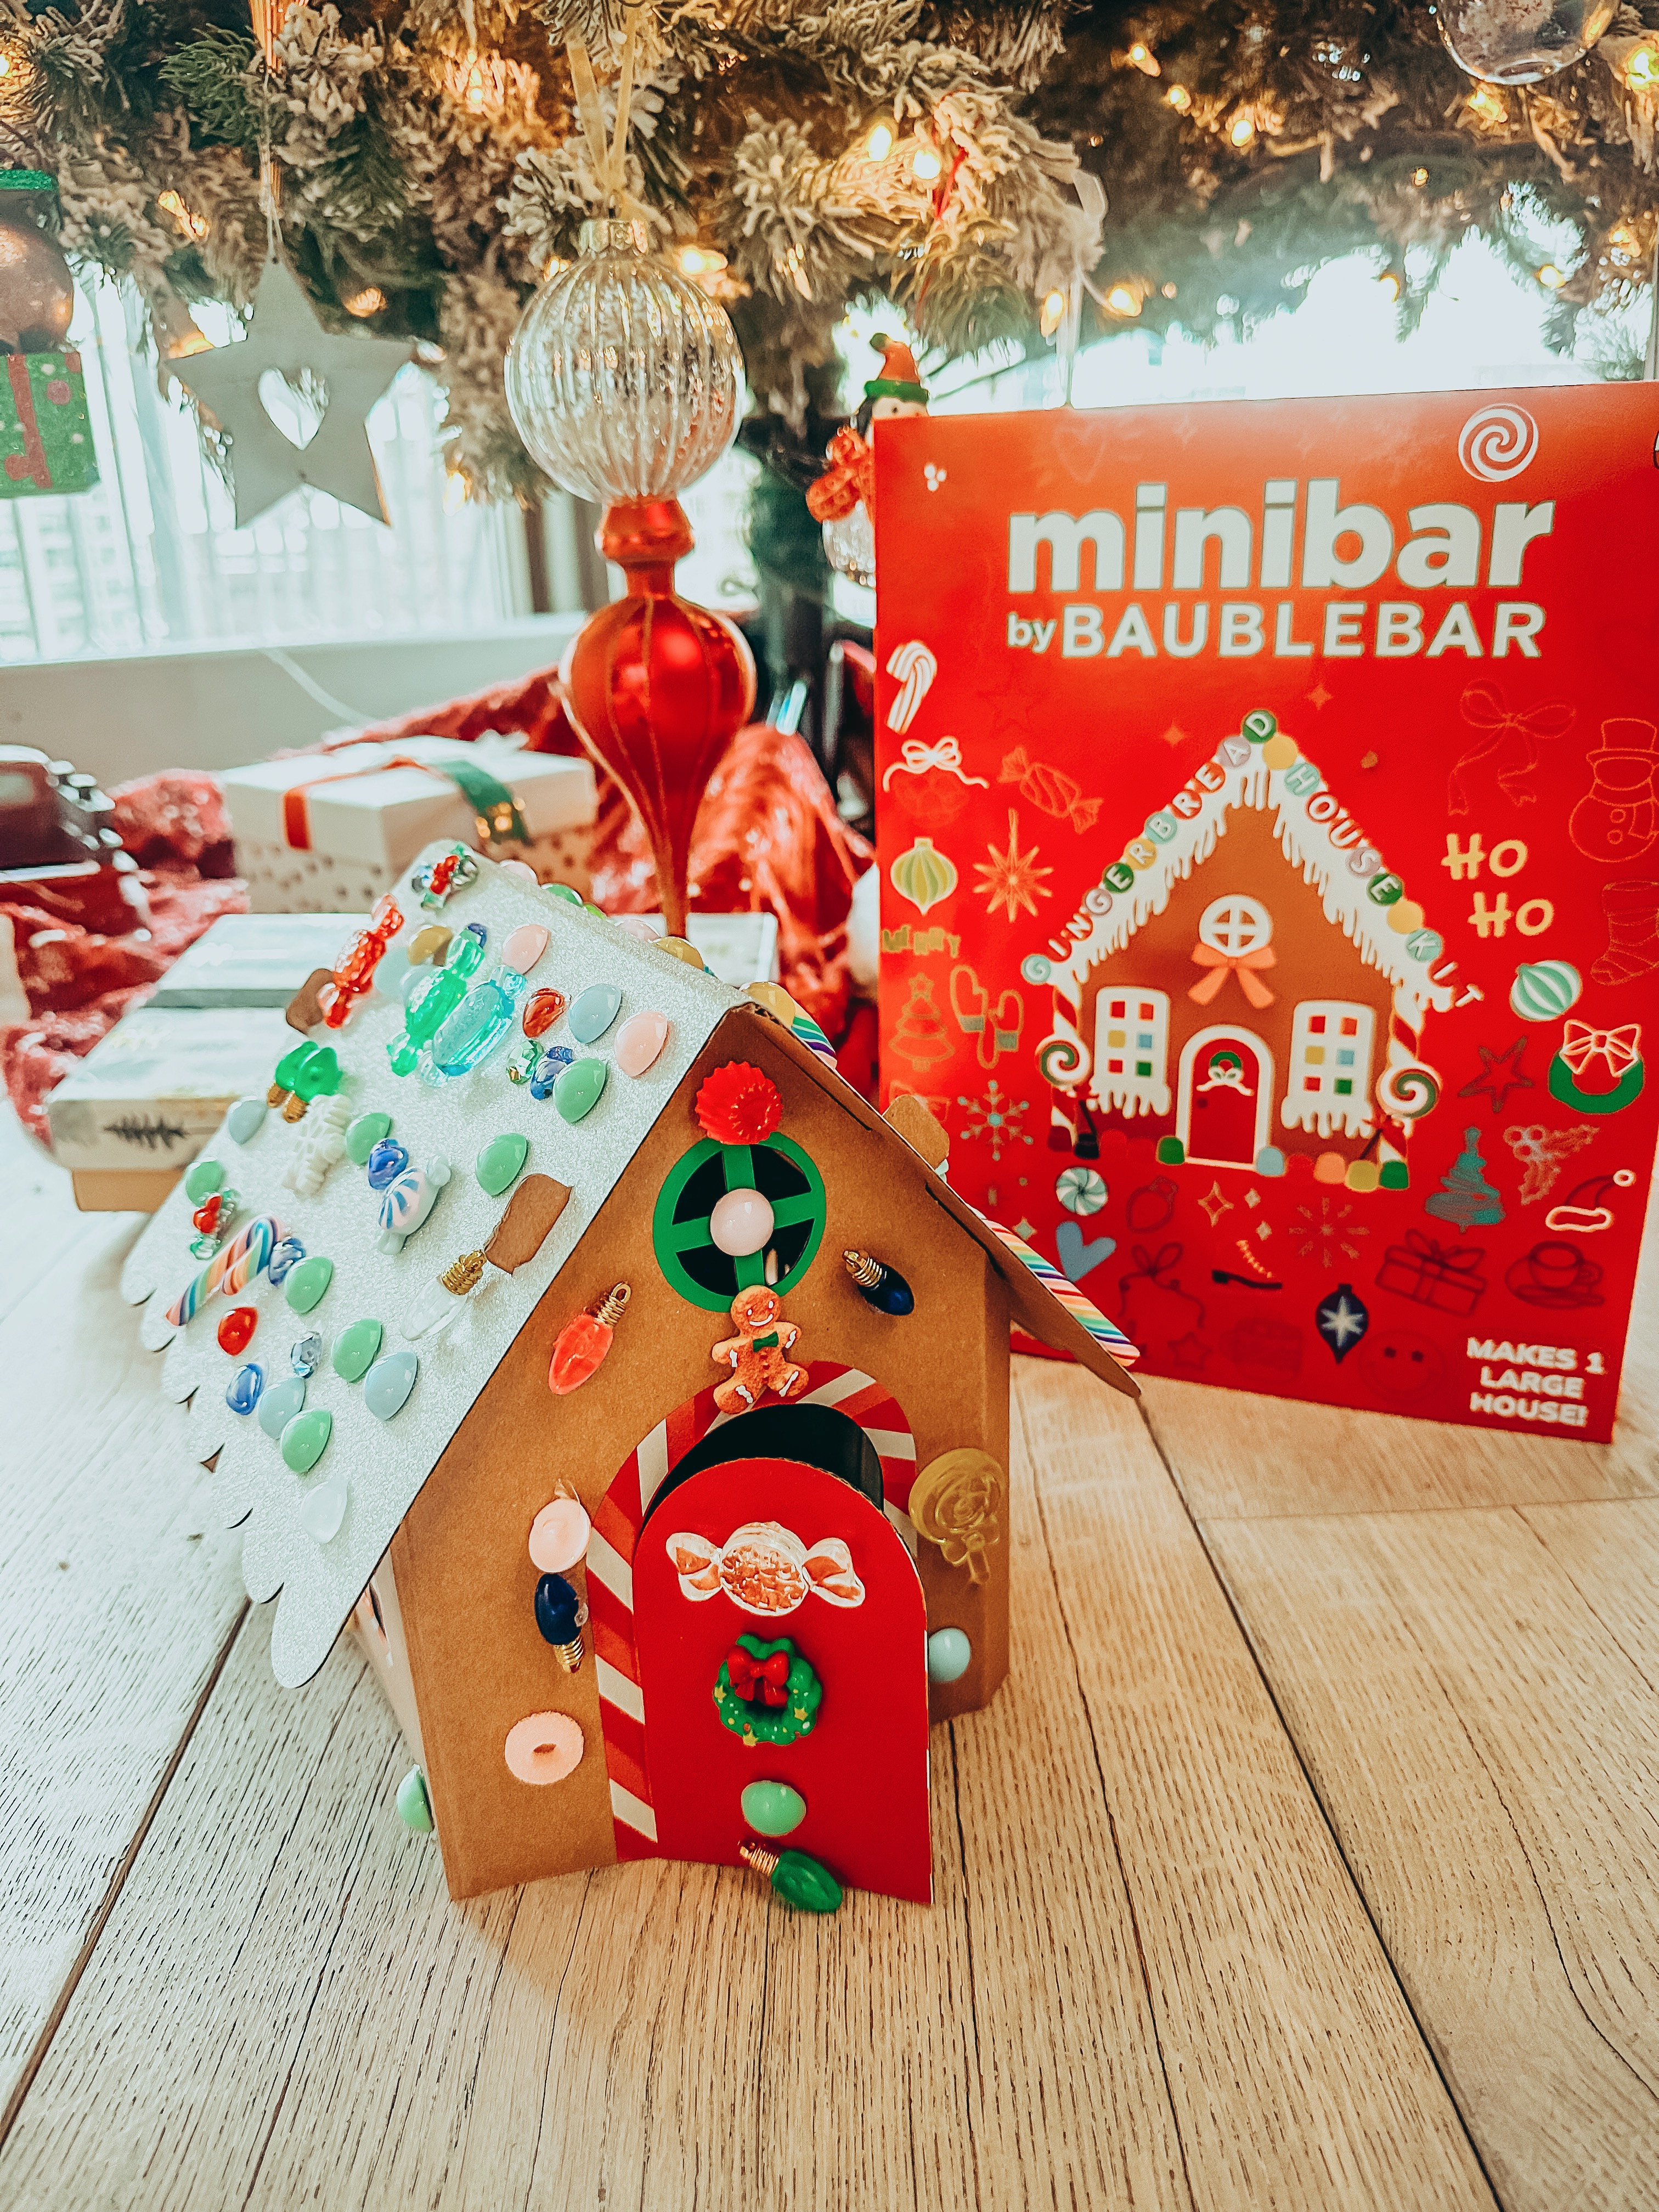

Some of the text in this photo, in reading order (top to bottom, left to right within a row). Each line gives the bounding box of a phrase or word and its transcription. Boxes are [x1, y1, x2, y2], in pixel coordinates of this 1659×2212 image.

[1007, 478, 1555, 593] minibar
[1007, 602, 1548, 659] by BAUBLEBAR
[1025, 712, 1485, 1008] GINGERBREAD HOUSE KIT
[1441, 832, 1529, 881] HO
[1467, 891, 1555, 939] HO
[1466, 1336, 1605, 1375] MAKES 1
[1480, 1365, 1584, 1400] LARGE
[1469, 1391, 1588, 1427] HOUSE!
